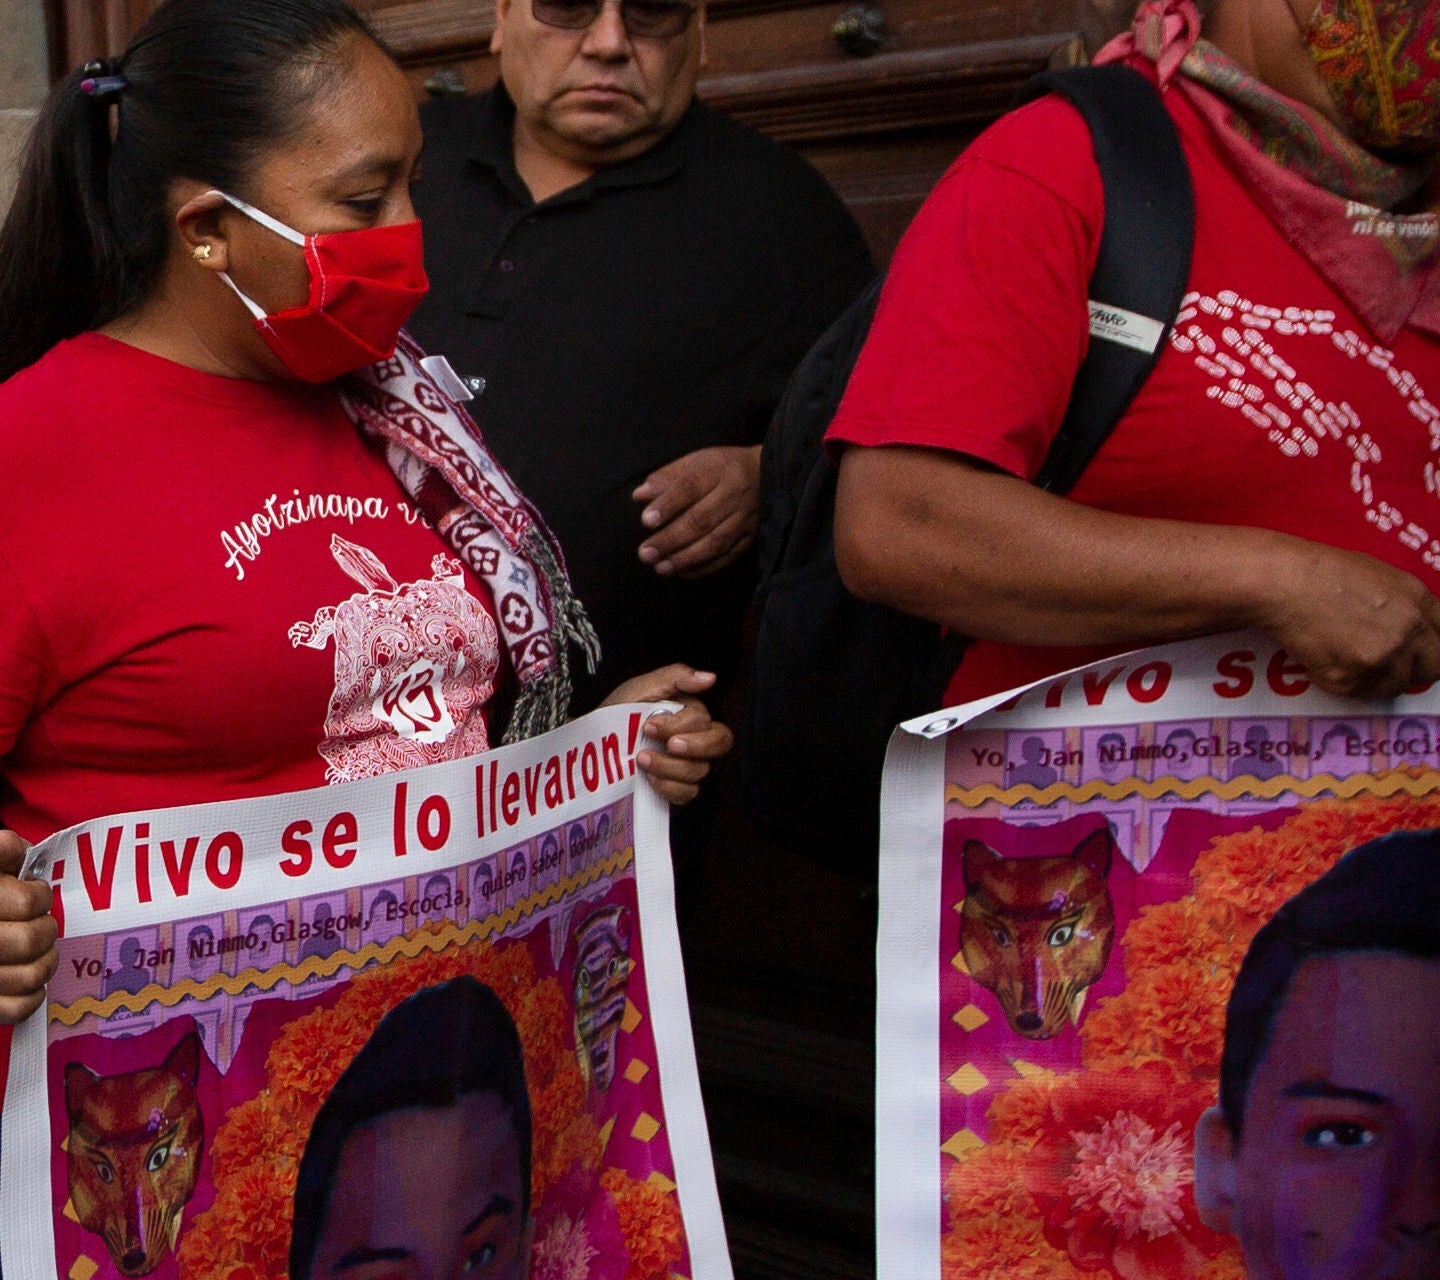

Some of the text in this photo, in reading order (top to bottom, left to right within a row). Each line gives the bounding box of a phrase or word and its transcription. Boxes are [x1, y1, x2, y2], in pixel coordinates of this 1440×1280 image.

[220, 488, 389, 581] Ayotzinapa
[278, 810, 359, 877] se
[392, 781, 451, 857] lo
[475, 711, 643, 839] llevaron!
[971, 746, 1017, 772] Yo,
[1037, 746, 1085, 768] Jan
[71, 957, 113, 981] Yo,
[132, 946, 176, 970] Jan
[385, 888, 472, 922] Escocia,
[480, 863, 528, 900] quiero
[530, 843, 566, 878] saber
